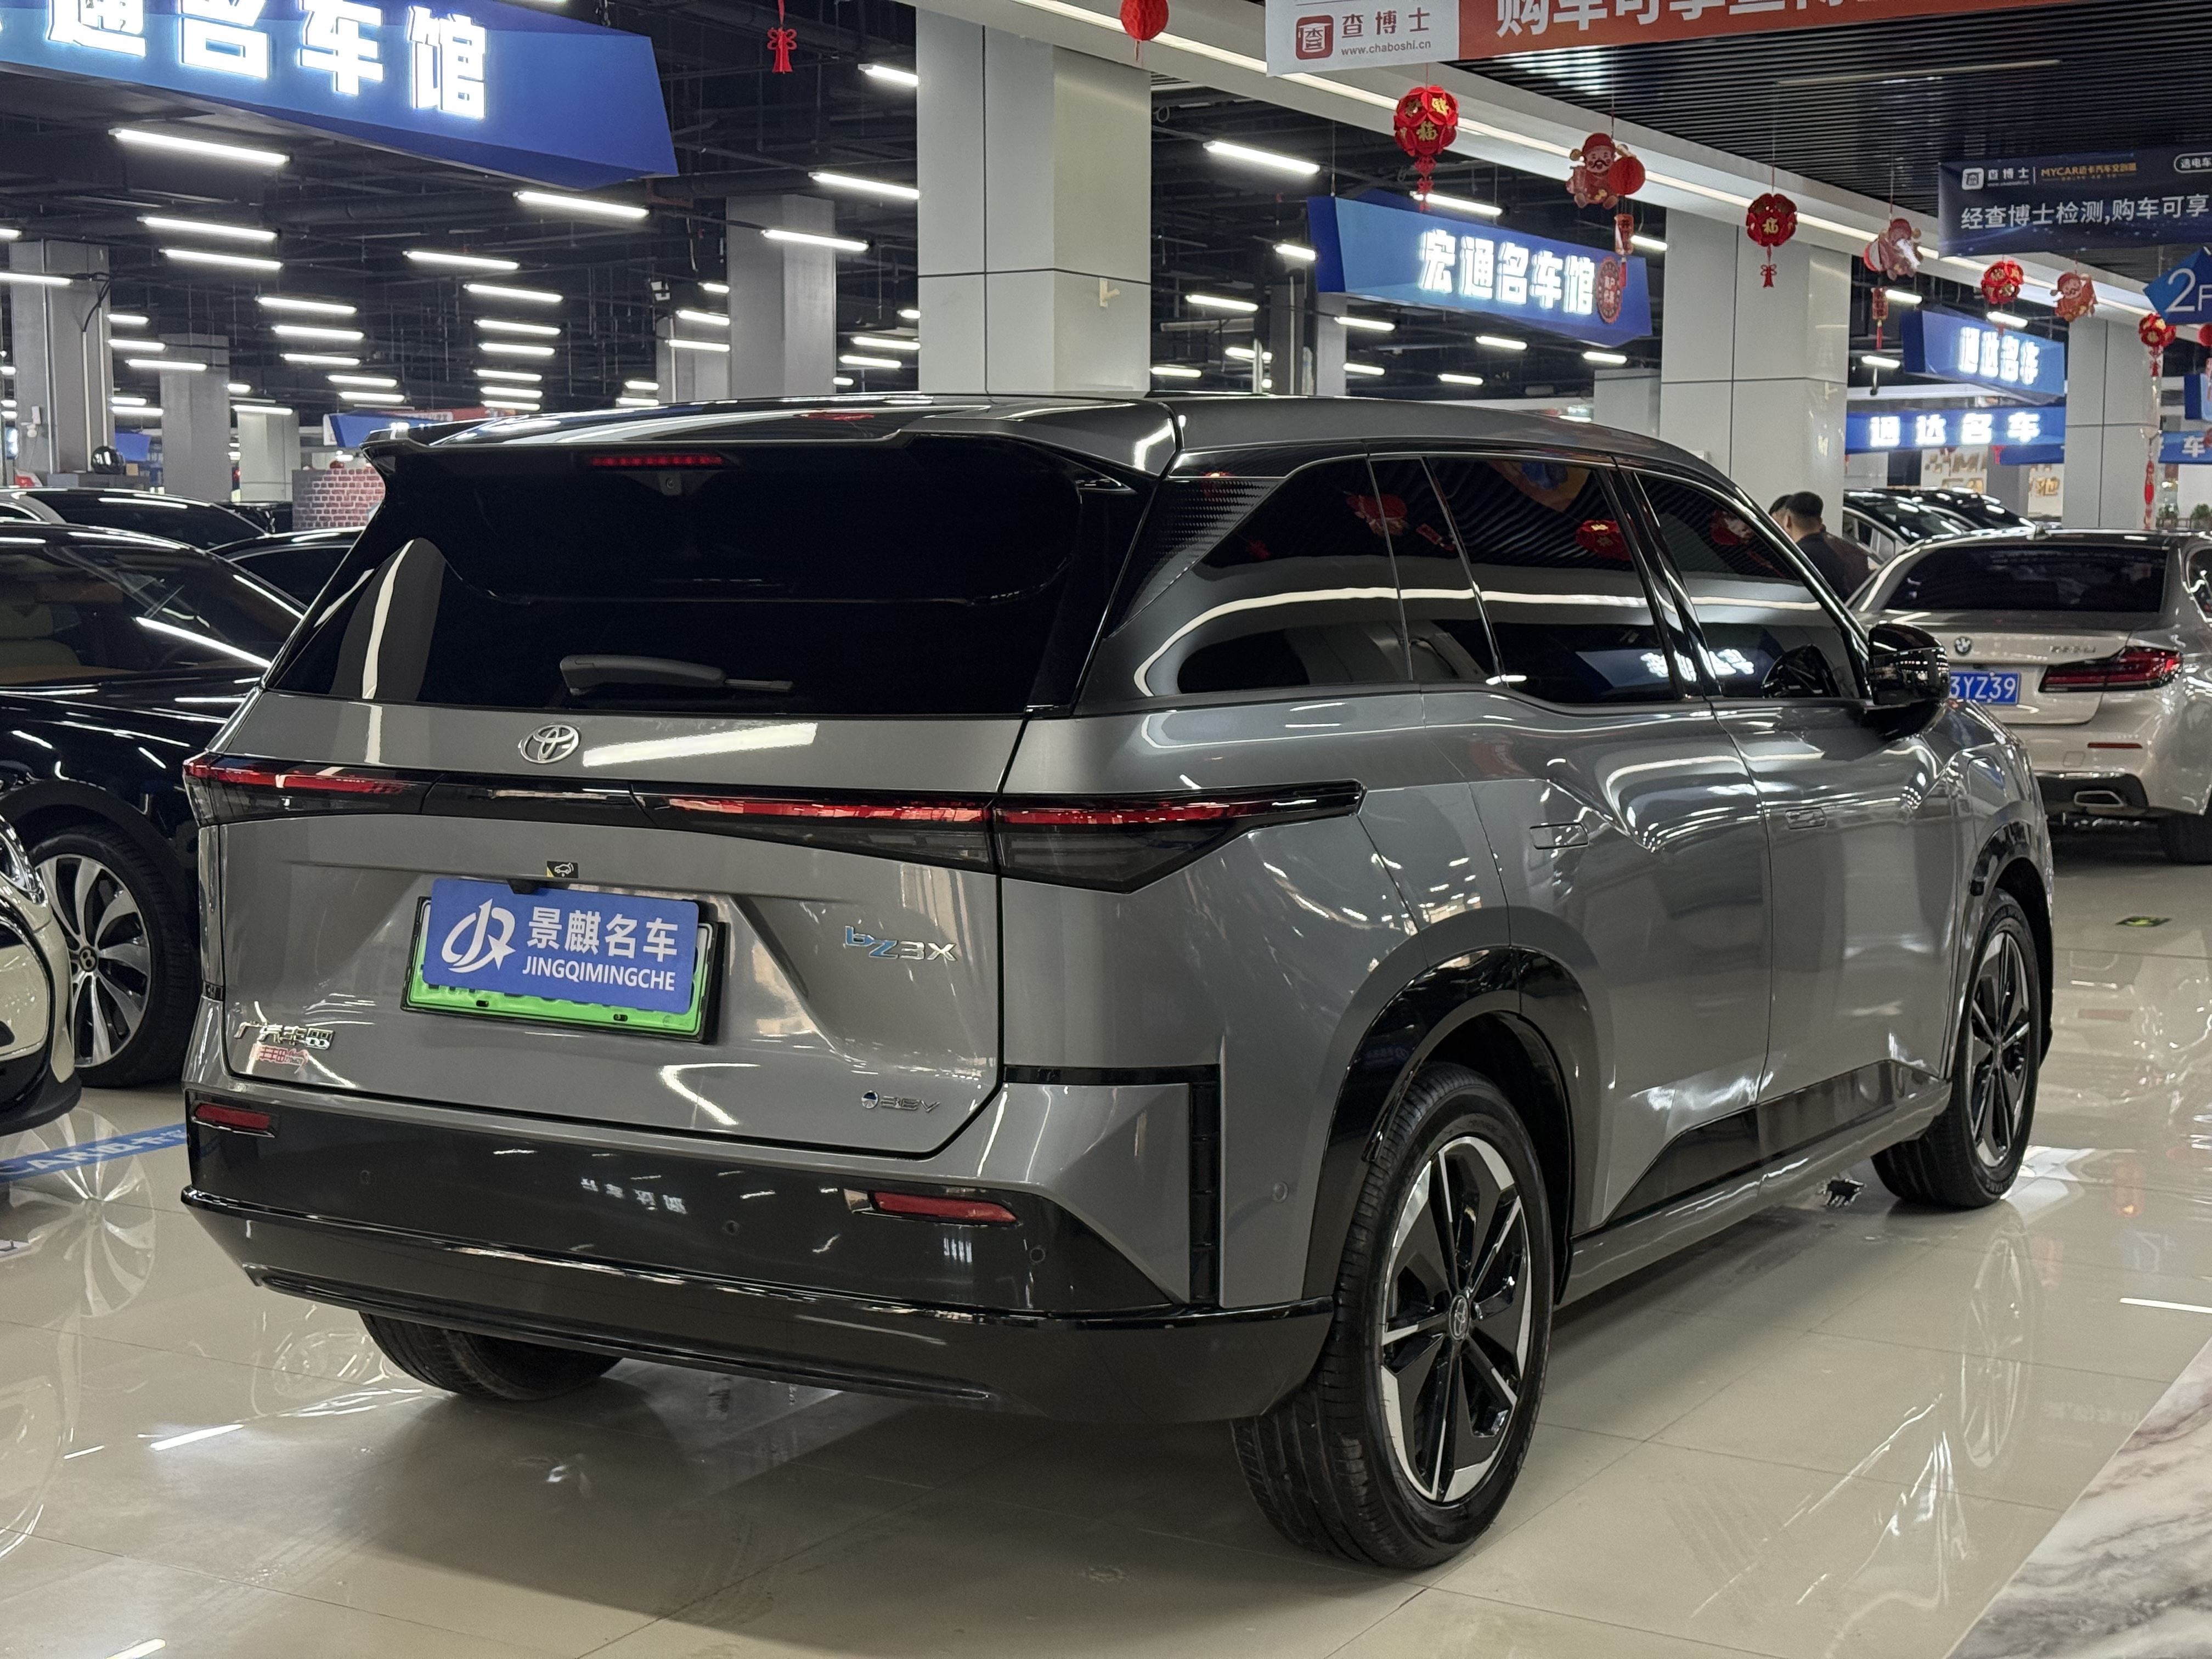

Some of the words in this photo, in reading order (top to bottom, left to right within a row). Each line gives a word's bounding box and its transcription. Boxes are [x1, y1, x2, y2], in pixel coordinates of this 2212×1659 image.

[1341, 7, 1430, 38] 查博士
[1341, 40, 1431, 55] www.chaboshi.cn
[1420, 228, 1595, 315] 宏通名车馆
[2165, 268, 2212, 313] 2F
[527, 906, 679, 962] 景麒名车
[522, 956, 676, 991] JINGQIMINGCHE
